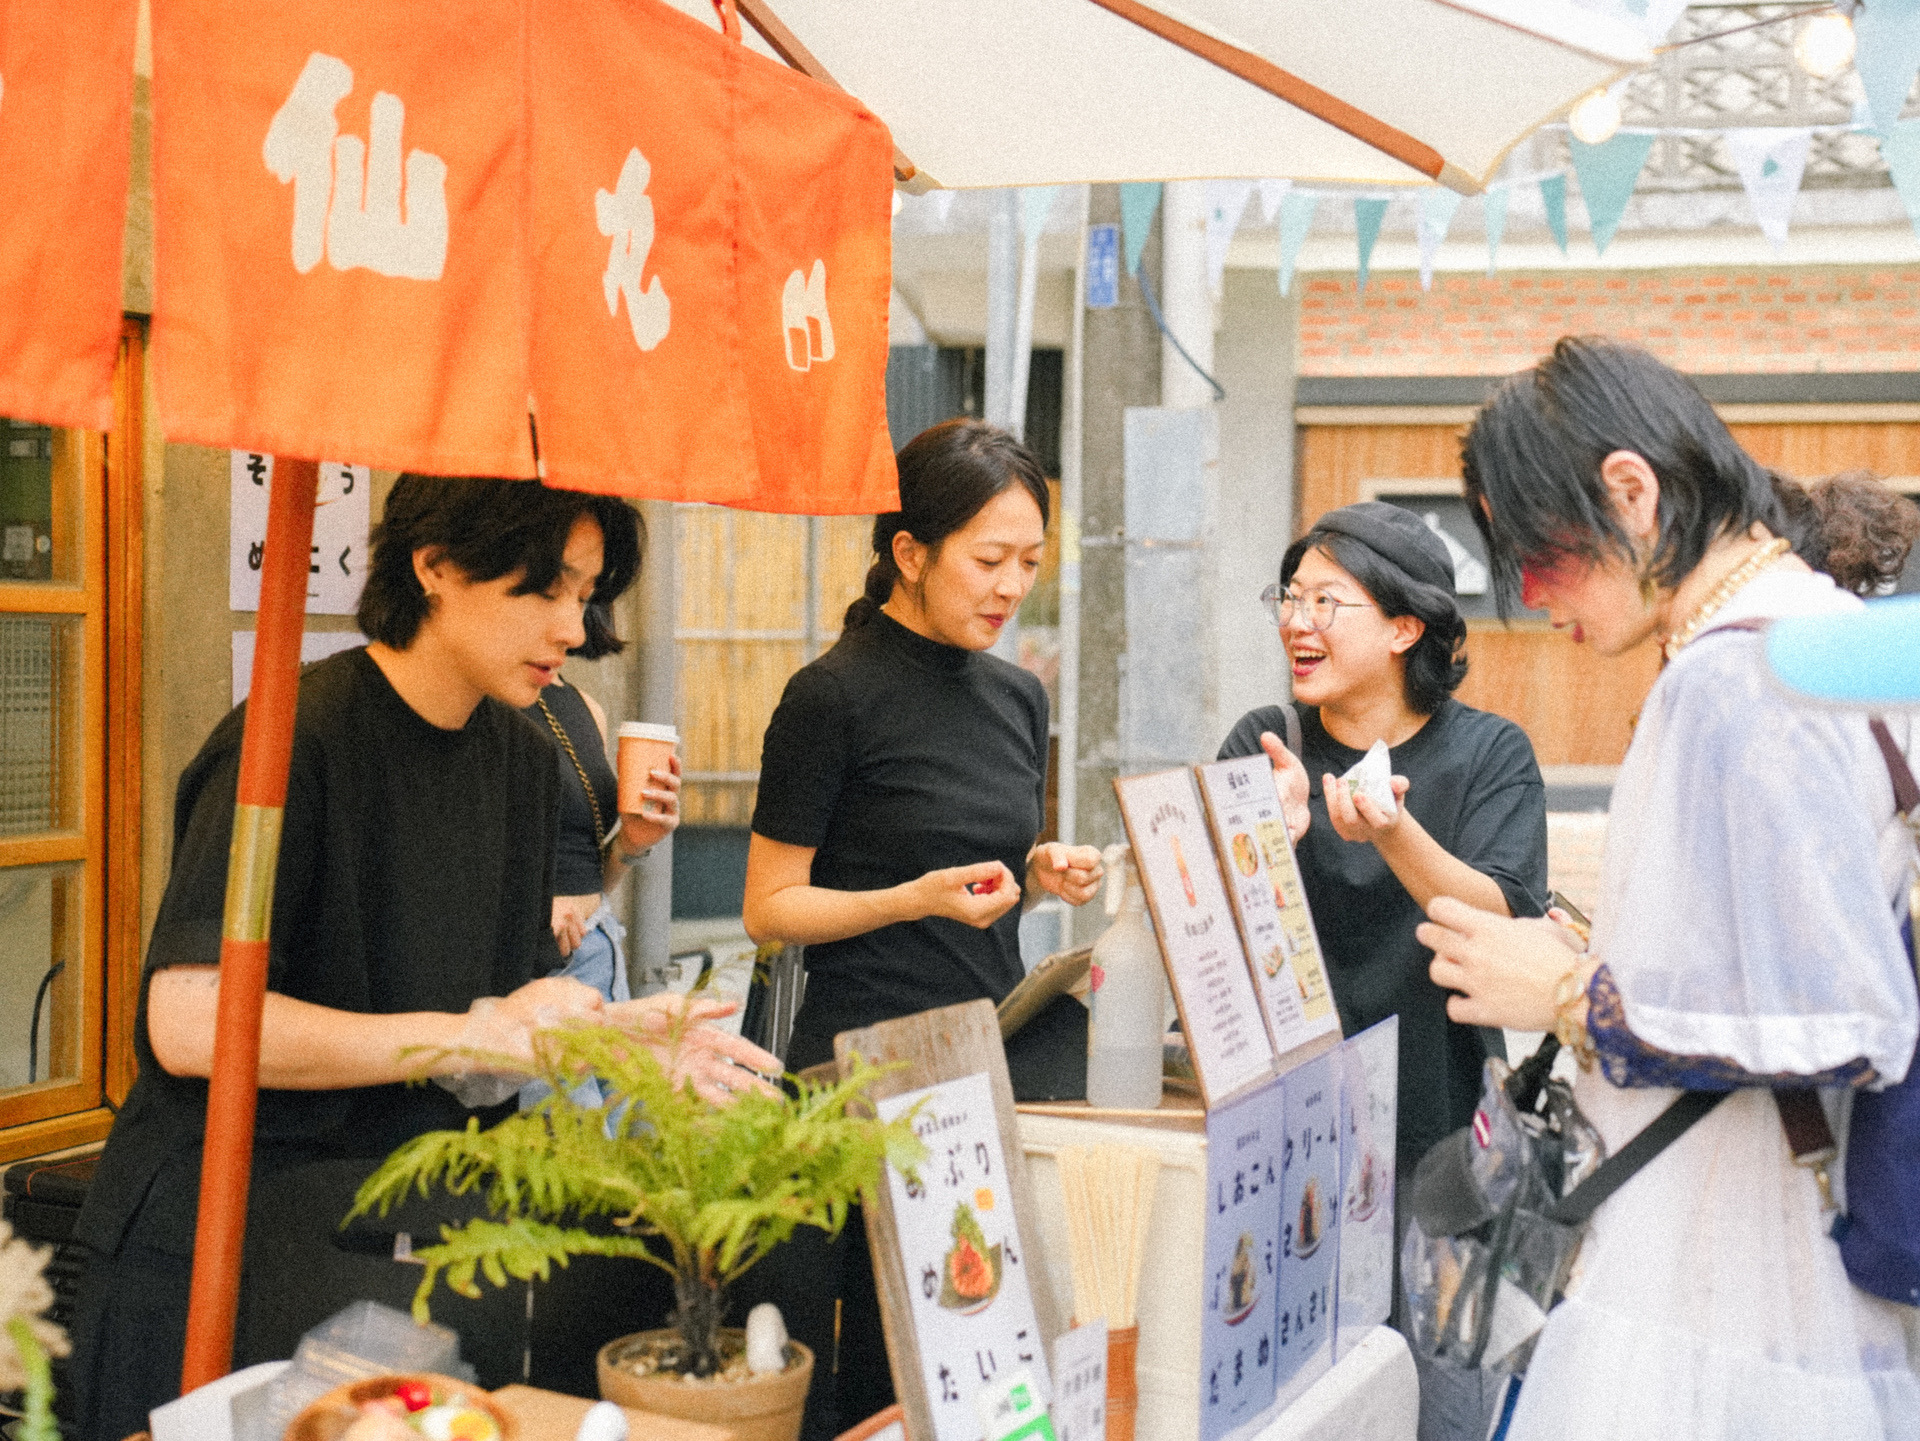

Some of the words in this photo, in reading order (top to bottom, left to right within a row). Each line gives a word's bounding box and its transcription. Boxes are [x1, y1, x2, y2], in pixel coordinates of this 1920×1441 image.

[1217, 1155, 1275, 1214] しおこん
[938, 1329, 1034, 1402] たいこ
